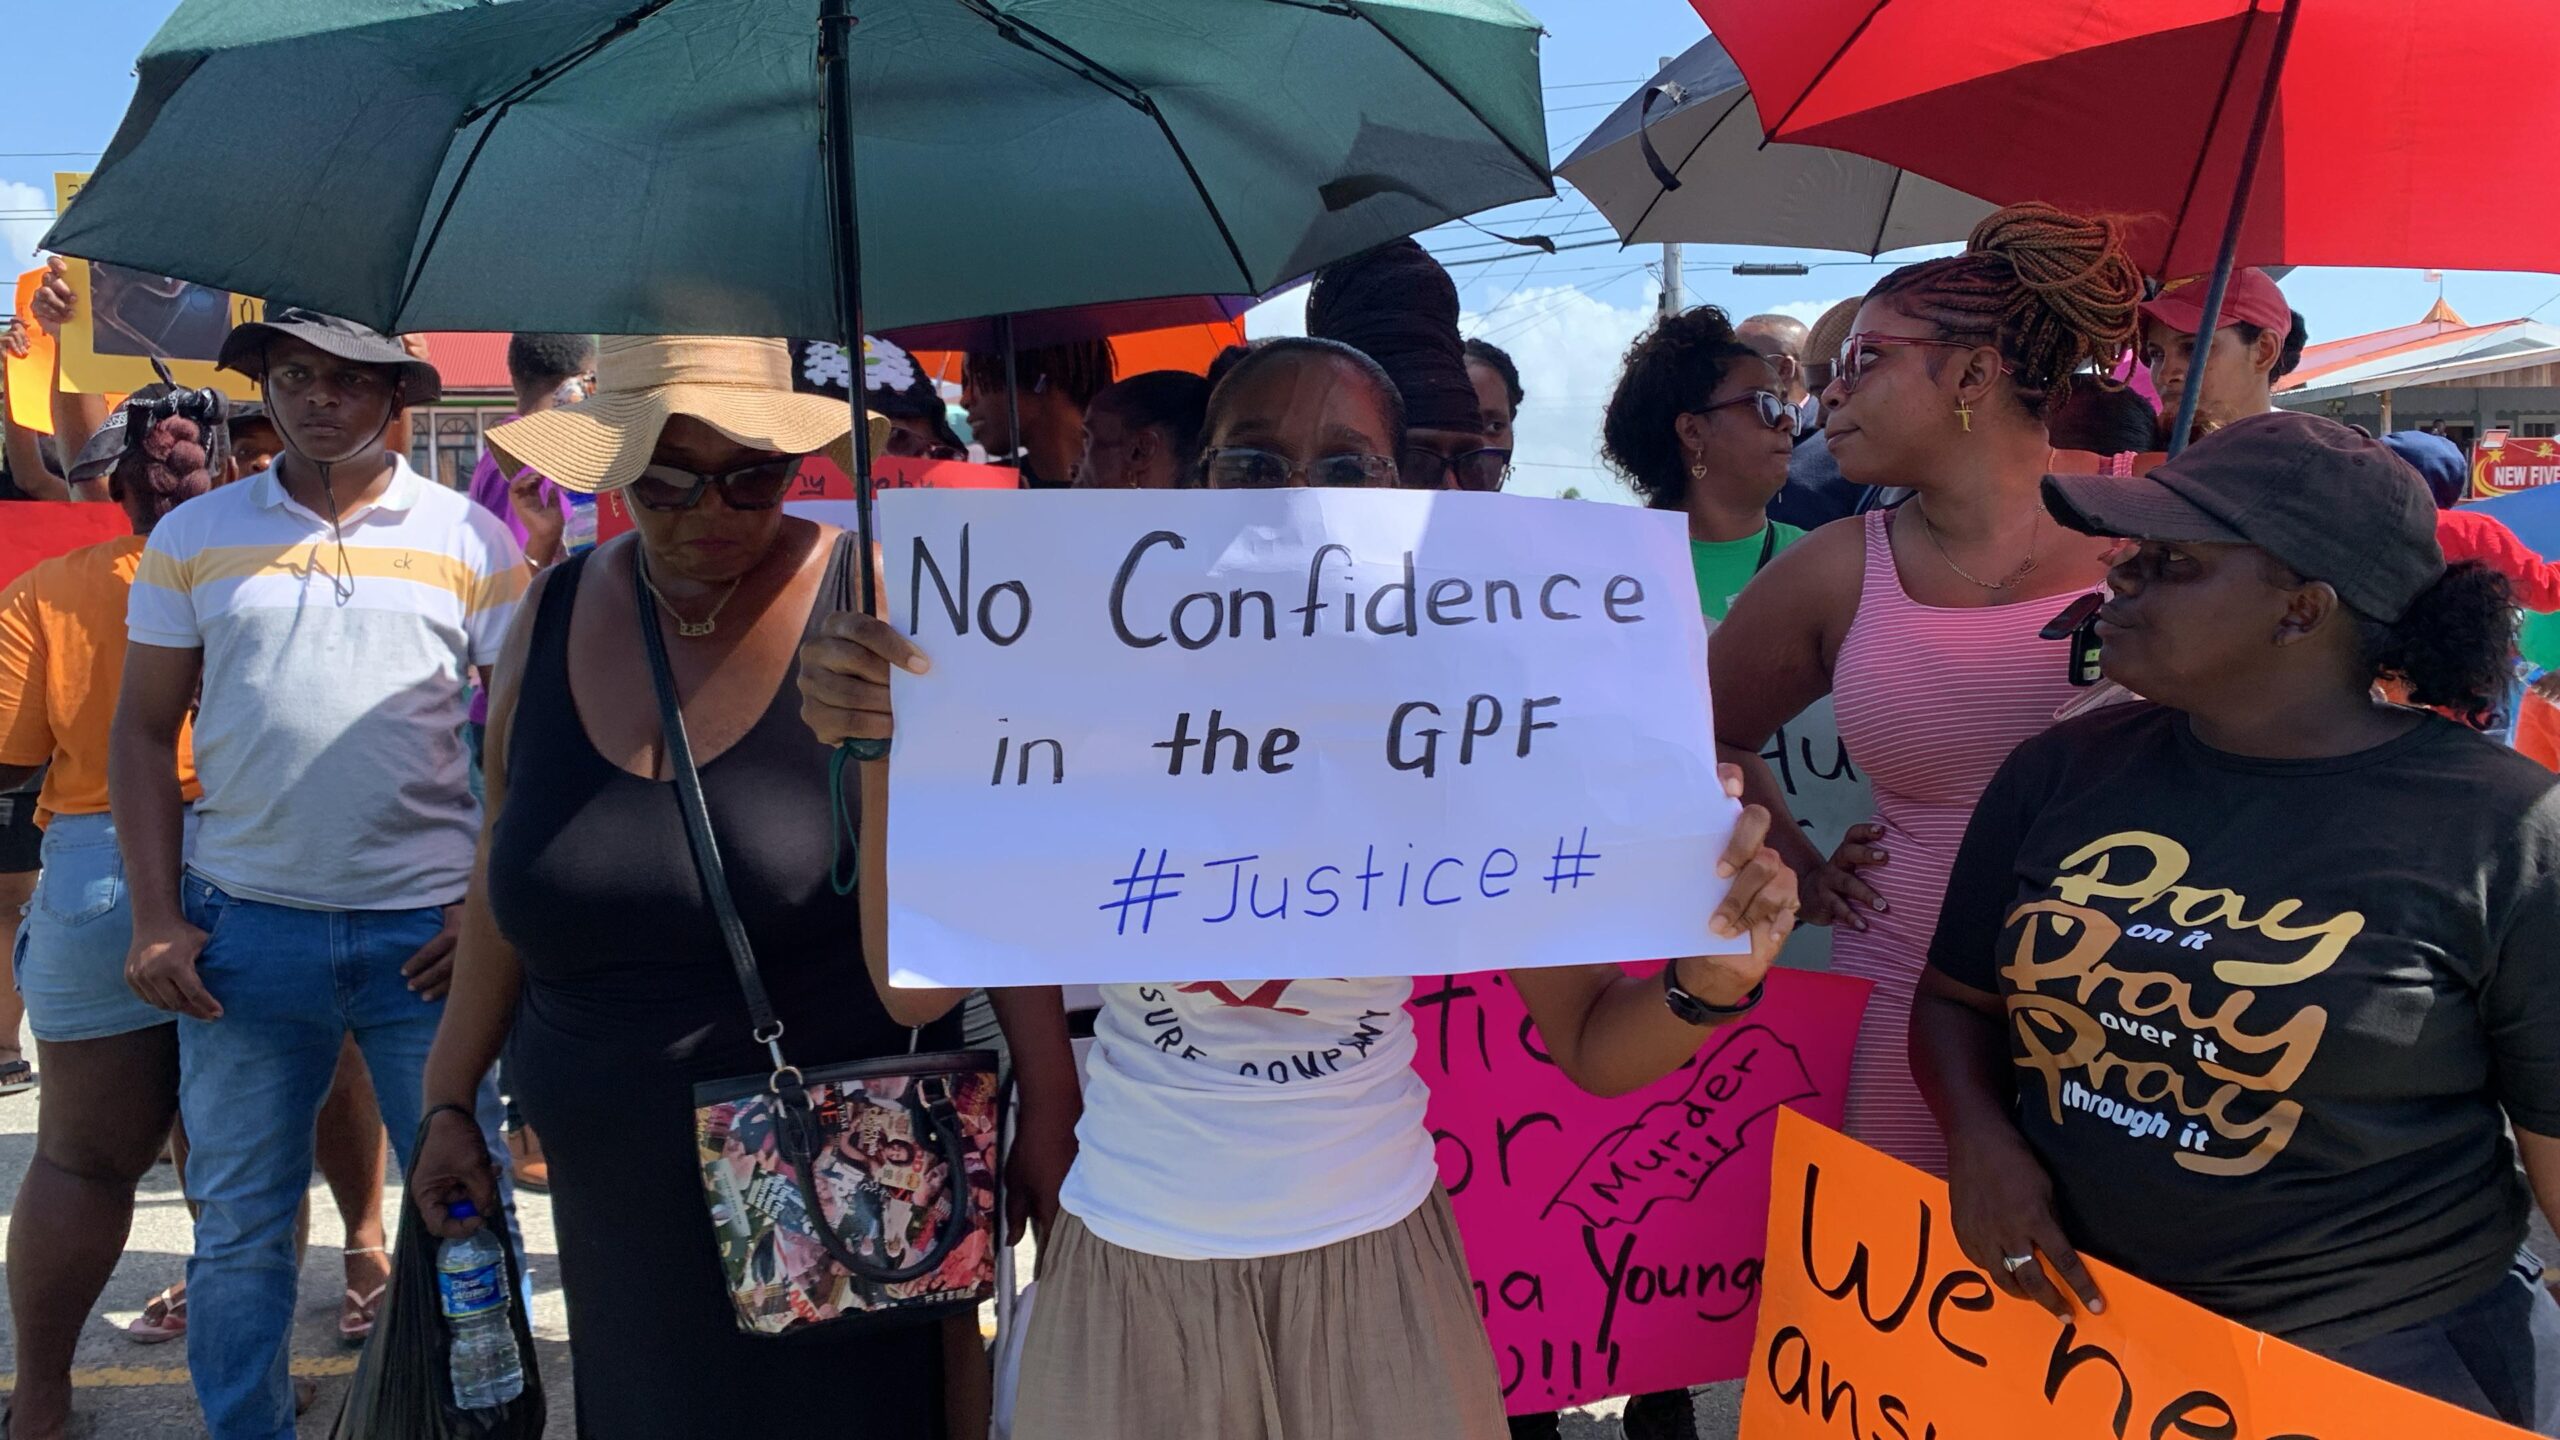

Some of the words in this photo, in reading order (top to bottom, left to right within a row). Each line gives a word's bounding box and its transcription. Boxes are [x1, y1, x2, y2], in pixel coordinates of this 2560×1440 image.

[2494, 465, 2528, 486] NEW
[393, 551, 413, 570] ck
[909, 522, 1032, 648] No
[1108, 530, 1646, 651] Confidence
[990, 718, 1065, 787] in
[1151, 709, 1301, 776] the
[1387, 694, 1562, 780] GPF
[2051, 831, 2365, 986] Pray
[2126, 925, 2173, 946] on
[2180, 929, 2213, 951] it
[2001, 900, 2328, 1092] Pray
[2099, 1011, 2175, 1049] over
[2191, 1033, 2220, 1064] it
[1590, 1048, 1759, 1206] Murder
[2007, 993, 2304, 1176] Pray
[2062, 1080, 2171, 1142] through
[2178, 1121, 2210, 1152] it
[1432, 1111, 1564, 1198] or
[1583, 1225, 1765, 1354] Young
[1803, 1162, 1996, 1367] We
[1767, 1325, 1937, 1440] ans
[2044, 1322, 2326, 1440] ne
